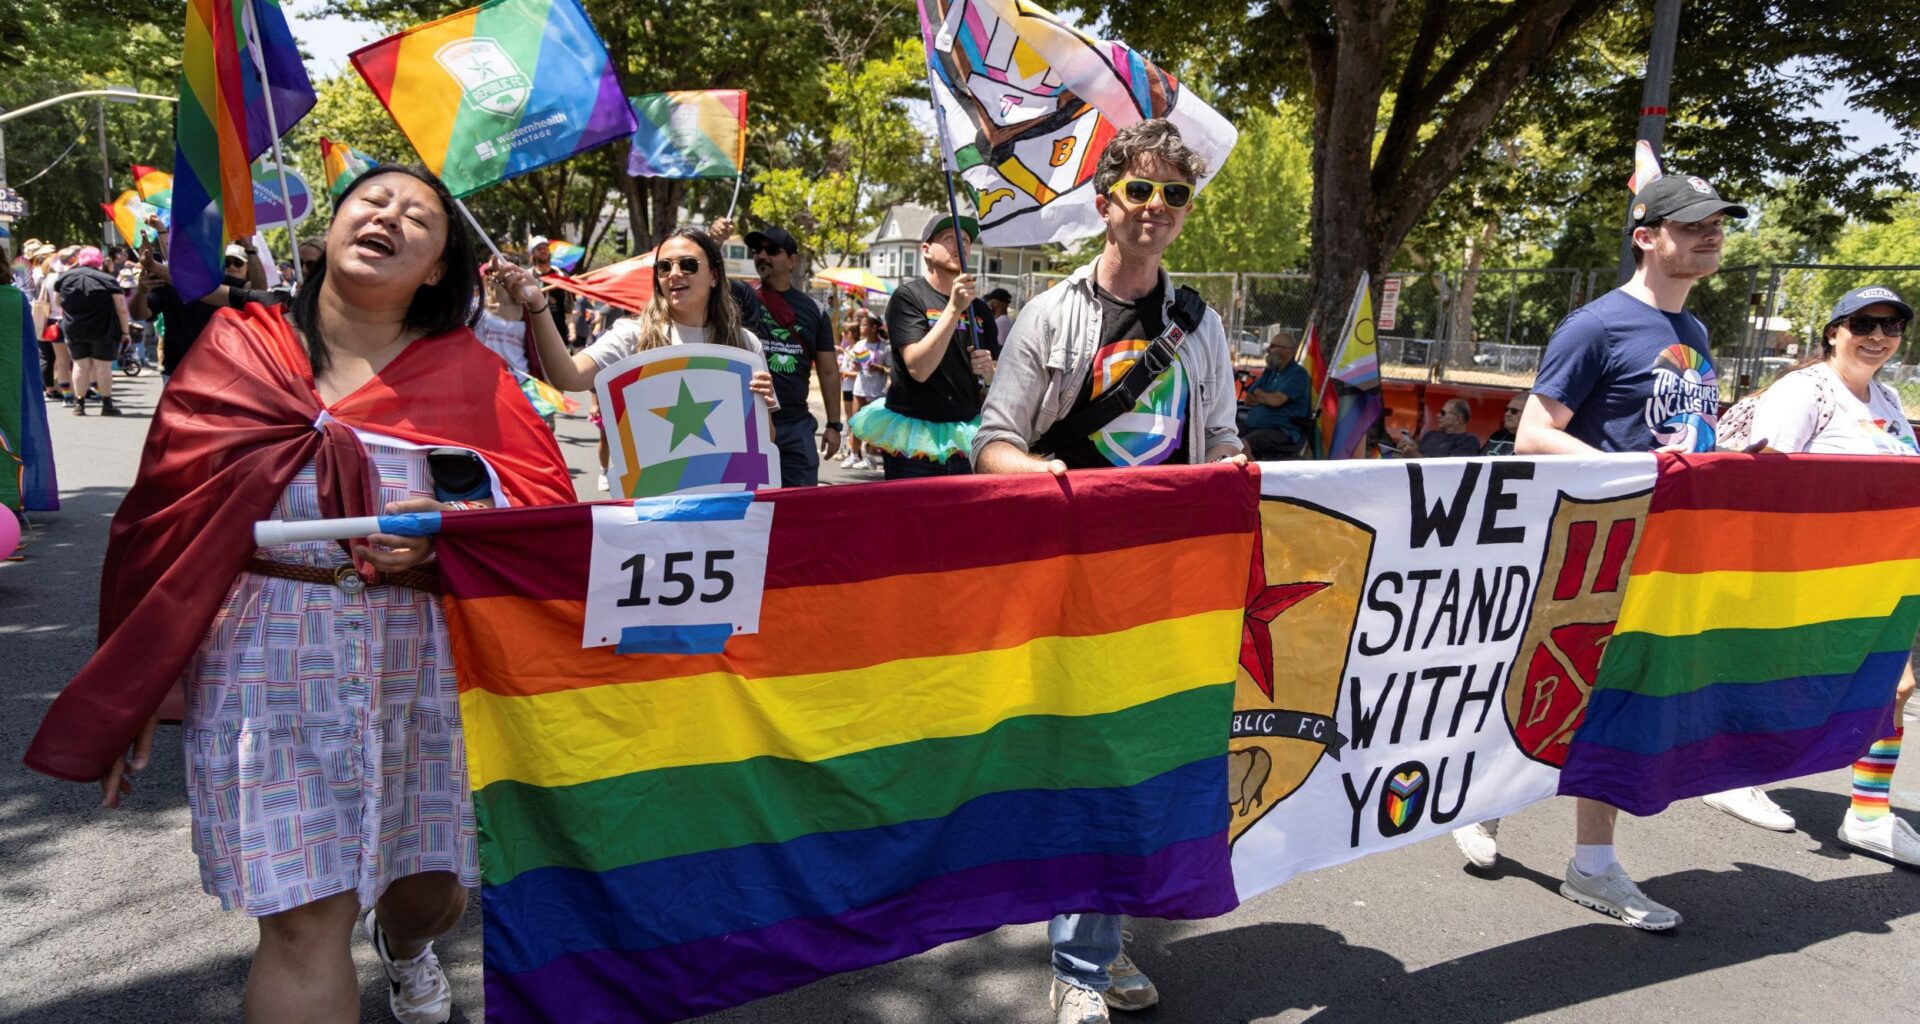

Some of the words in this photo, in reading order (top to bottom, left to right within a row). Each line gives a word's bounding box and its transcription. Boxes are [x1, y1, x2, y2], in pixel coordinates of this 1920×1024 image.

[496, 112, 567, 144] westernhealth
[501, 129, 552, 153] ADVANTAGE
[1050, 136, 1077, 167] B
[1652, 368, 1679, 397] THE
[1679, 380, 1716, 401] FUTURE
[1406, 461, 1536, 549] WE
[616, 550, 735, 607] 155
[1358, 565, 1530, 656] STAND
[1233, 713, 1275, 733] BLIC
[1298, 717, 1325, 738] FC
[1350, 661, 1505, 750] WITH
[1526, 675, 1559, 728] B
[1342, 751, 1475, 848] YOU
